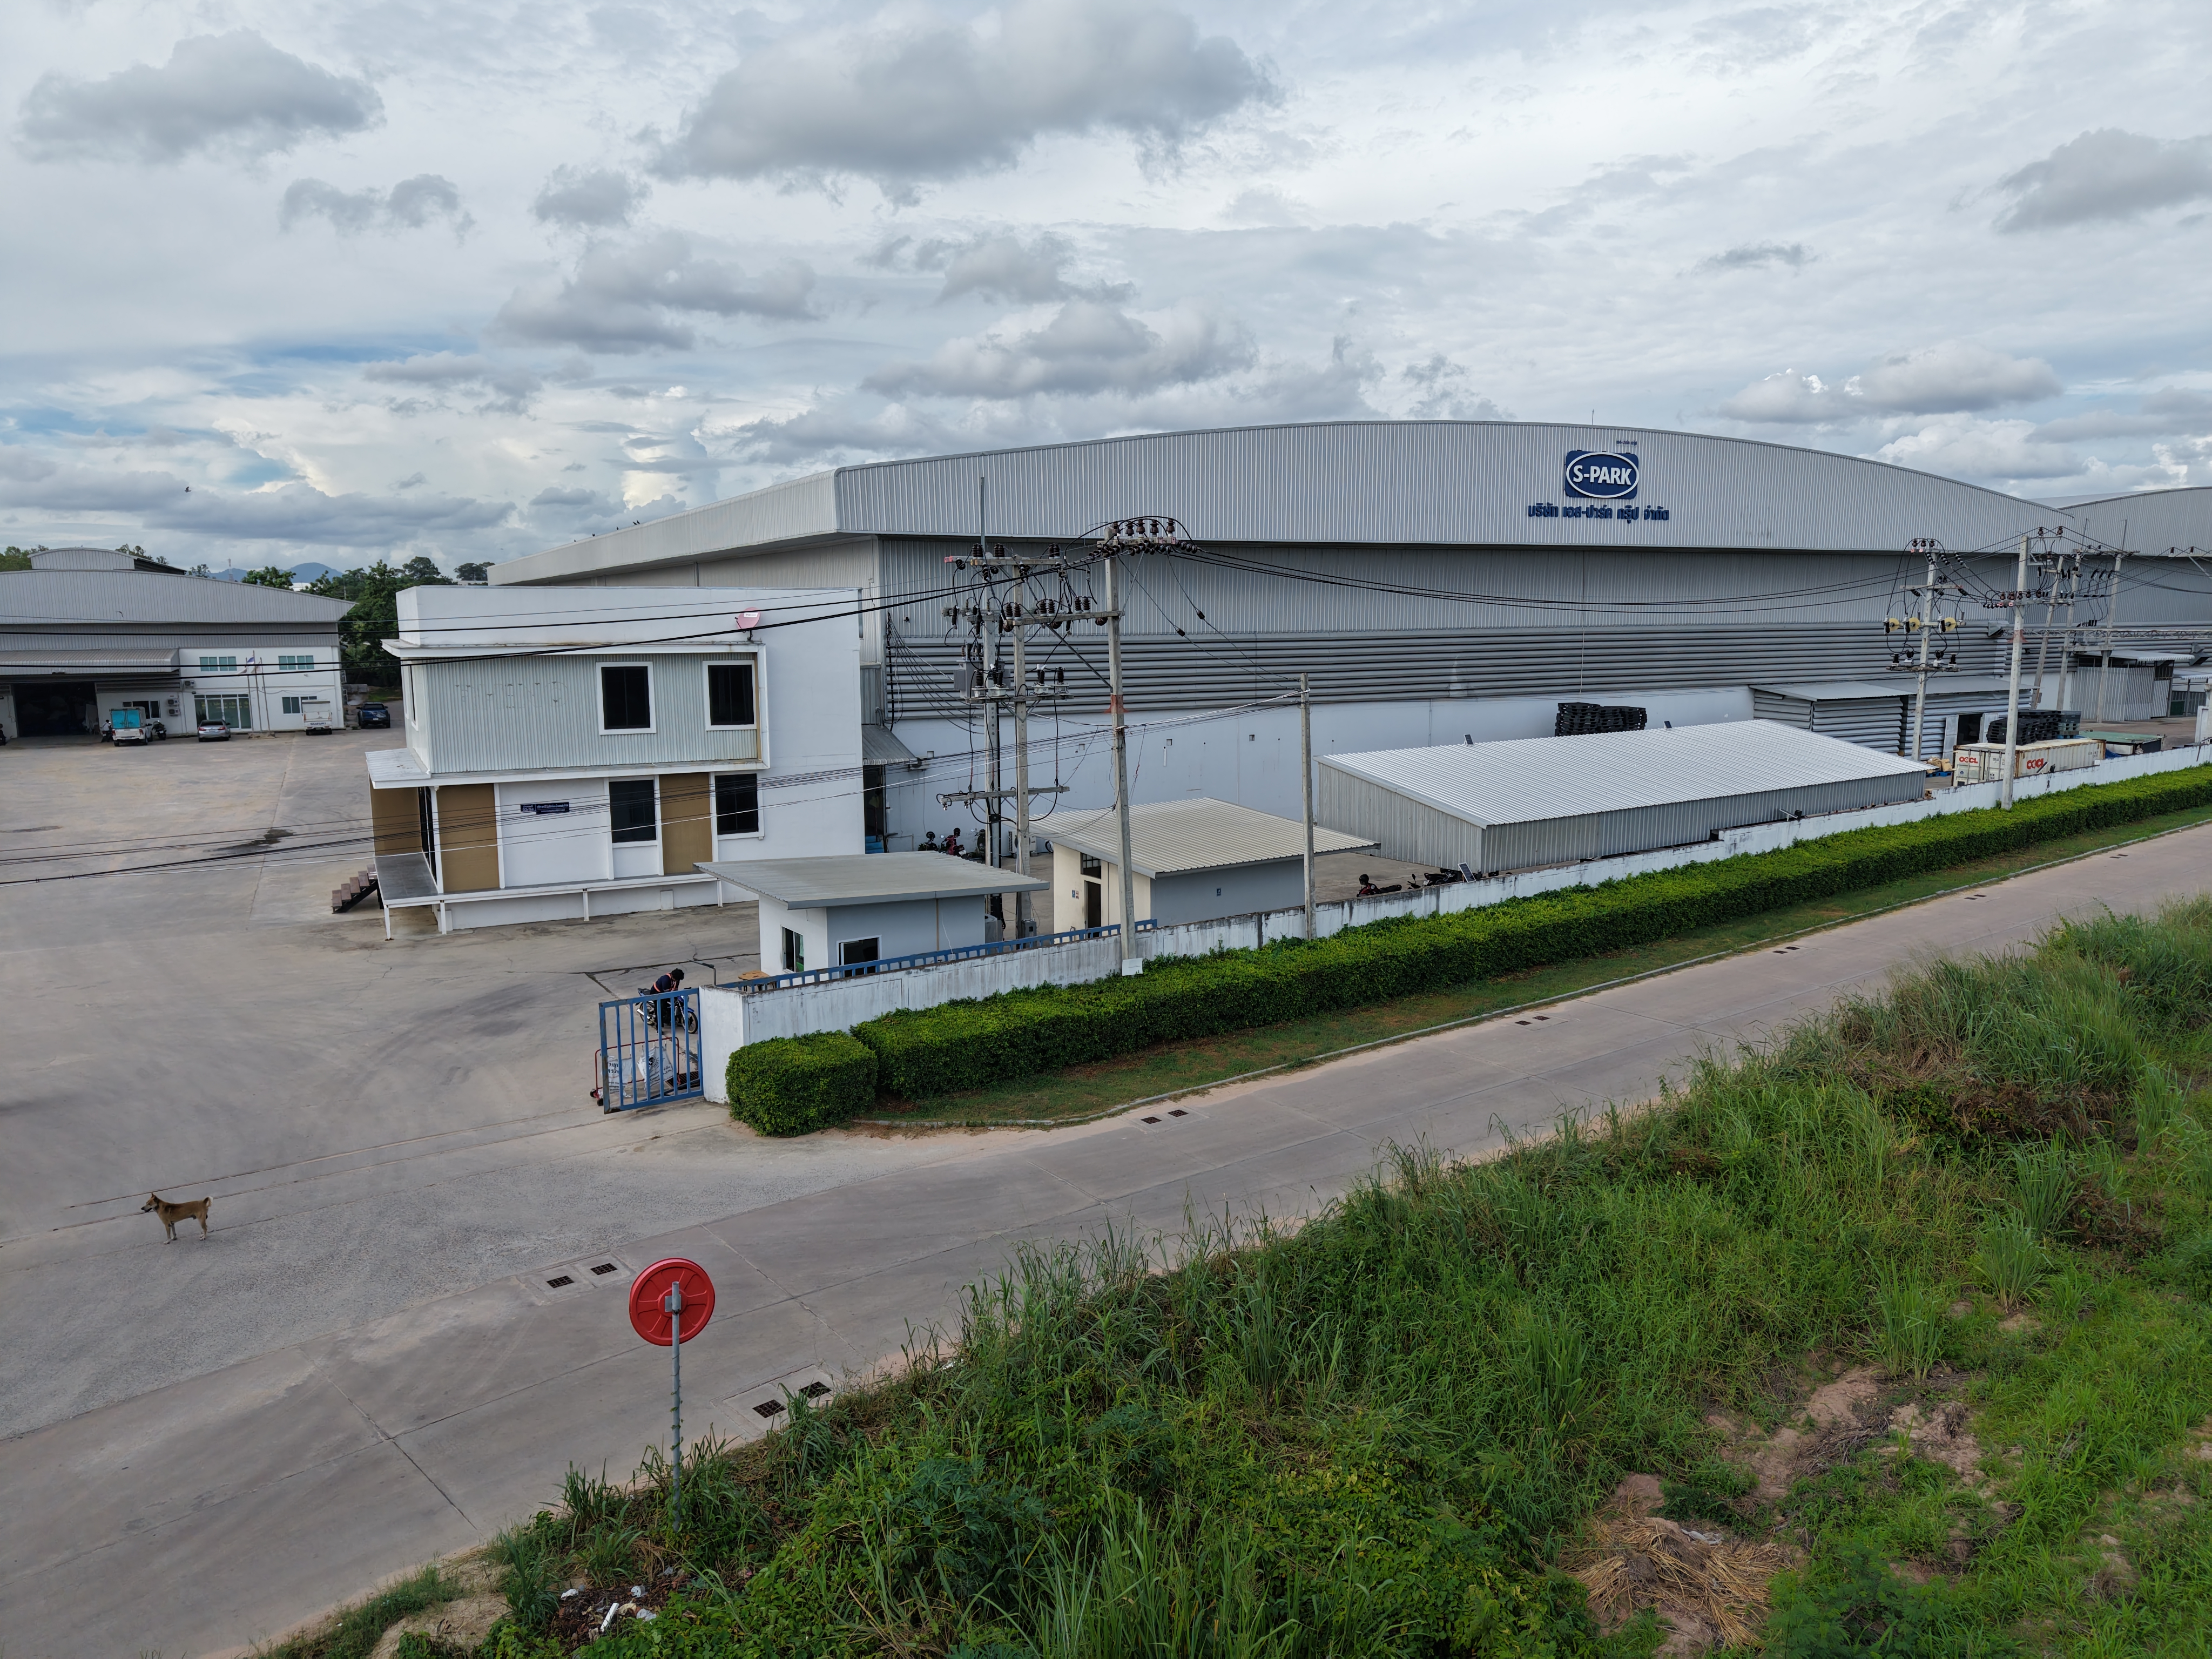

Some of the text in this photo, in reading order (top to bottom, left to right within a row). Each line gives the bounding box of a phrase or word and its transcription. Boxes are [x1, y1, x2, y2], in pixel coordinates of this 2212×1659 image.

[1573, 465, 1633, 485] S-PARK
[1528, 502, 1669, 524] บริษัท เอส-ปาร์ค กรุ๊ป จำกัด
